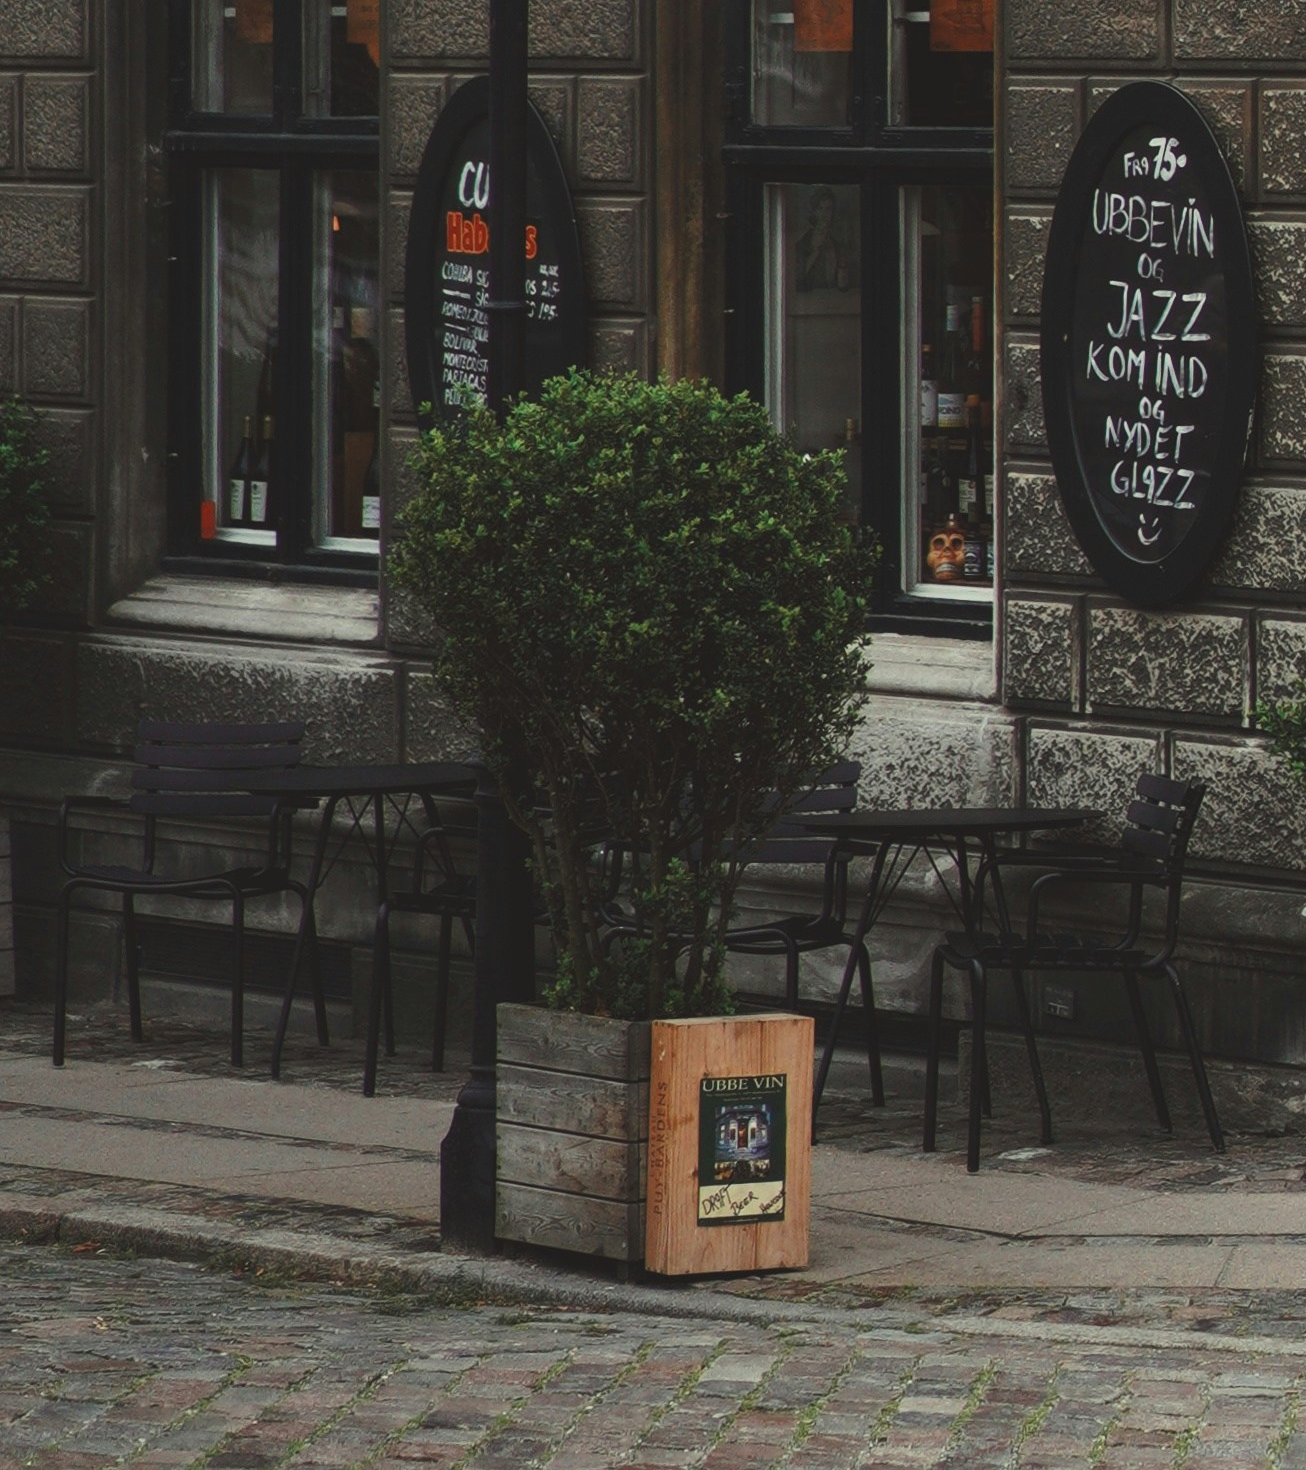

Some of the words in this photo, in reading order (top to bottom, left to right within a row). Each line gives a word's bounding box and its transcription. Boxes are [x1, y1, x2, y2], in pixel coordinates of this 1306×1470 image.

[1123, 151, 1149, 179] FRA
[447, 211, 538, 260] Habs
[1137, 252, 1164, 284] OG
[1107, 280, 1211, 342] JAZZ
[1087, 340, 1145, 391] KOM
[1155, 344, 1208, 399] IND
[1139, 396, 1165, 425] OG
[1105, 415, 1151, 458] NYD
[1154, 424, 1195, 464] ET
[1110, 460, 1195, 509] GLAZZ
[702, 1078, 749, 1092] UBBE
[753, 1075, 784, 1089] VIN
[702, 1181, 733, 1216] DRAFT
